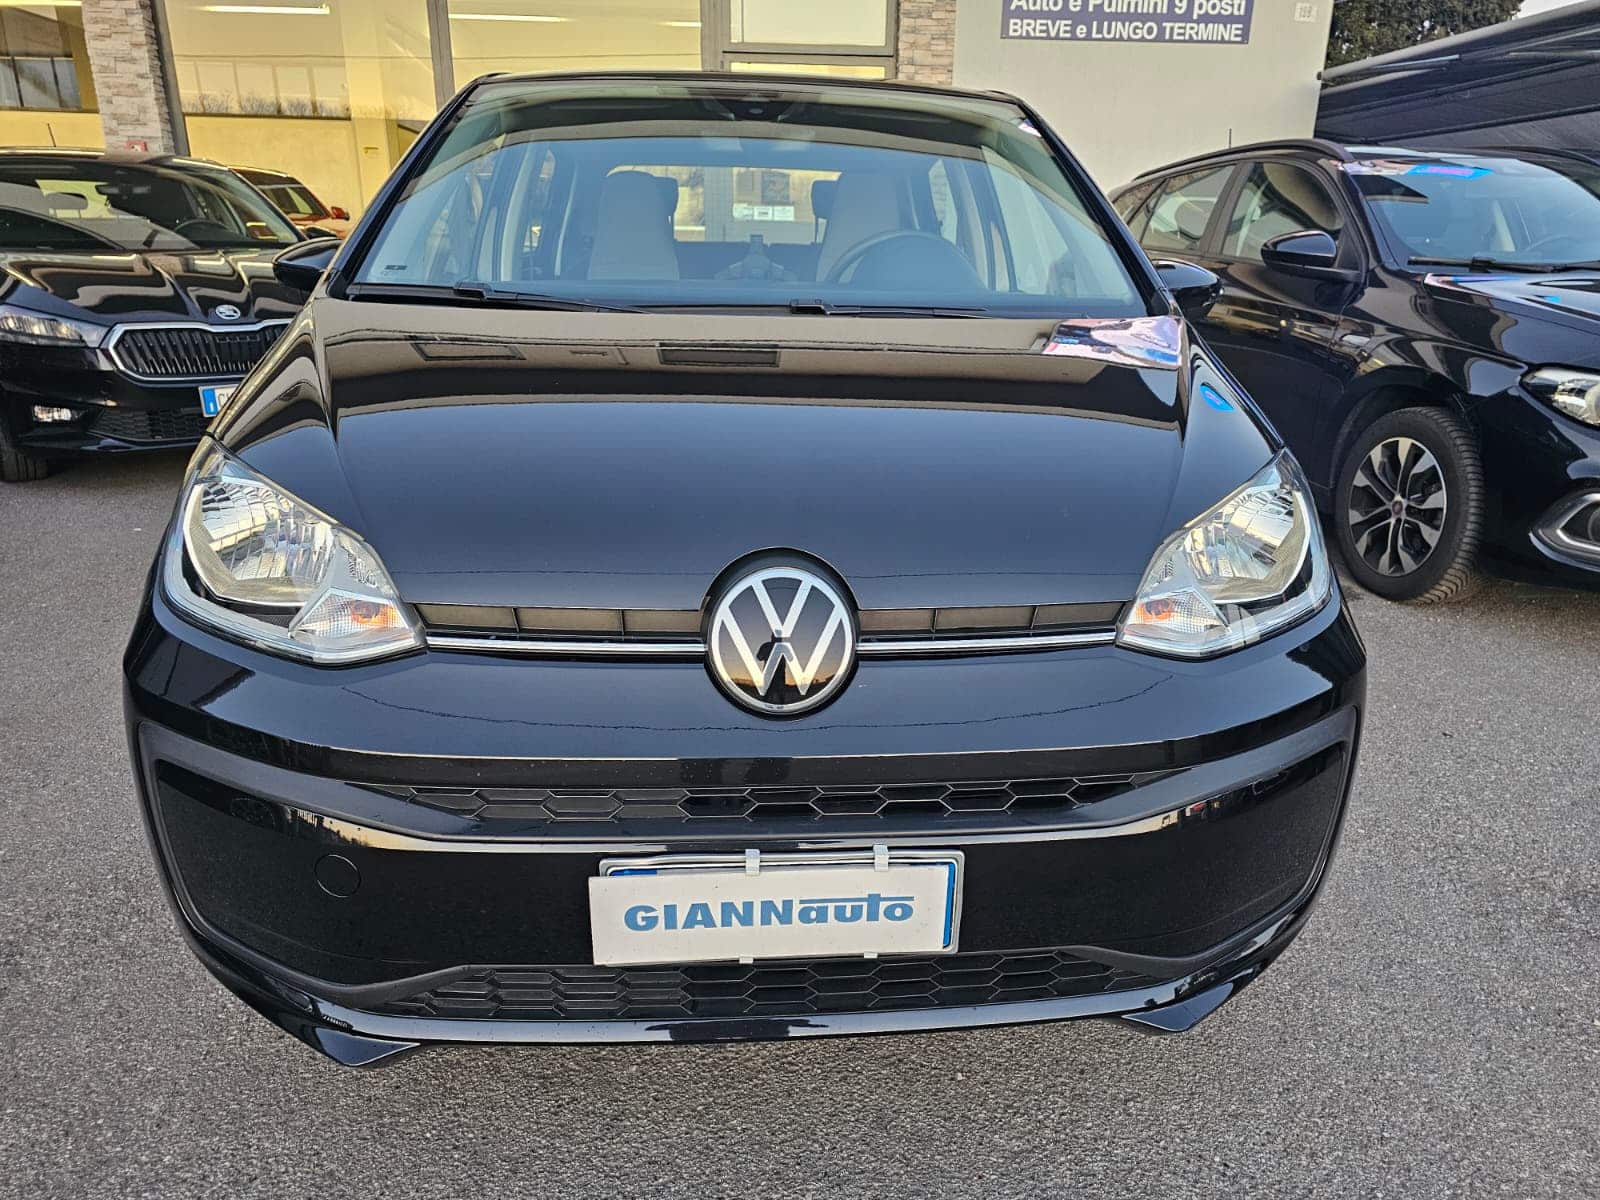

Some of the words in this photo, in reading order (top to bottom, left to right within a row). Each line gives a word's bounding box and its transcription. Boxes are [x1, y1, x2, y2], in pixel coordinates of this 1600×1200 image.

[1069, 0, 1082, 11] e
[1174, 0, 1188, 14] 9
[1193, 0, 1246, 20] posti
[1009, 19, 1072, 37] BREVE
[1076, 24, 1087, 38] e
[1092, 21, 1157, 40] LUNGO
[1162, 22, 1243, 41] TERMINE
[624, 893, 915, 932] GIANNauto
